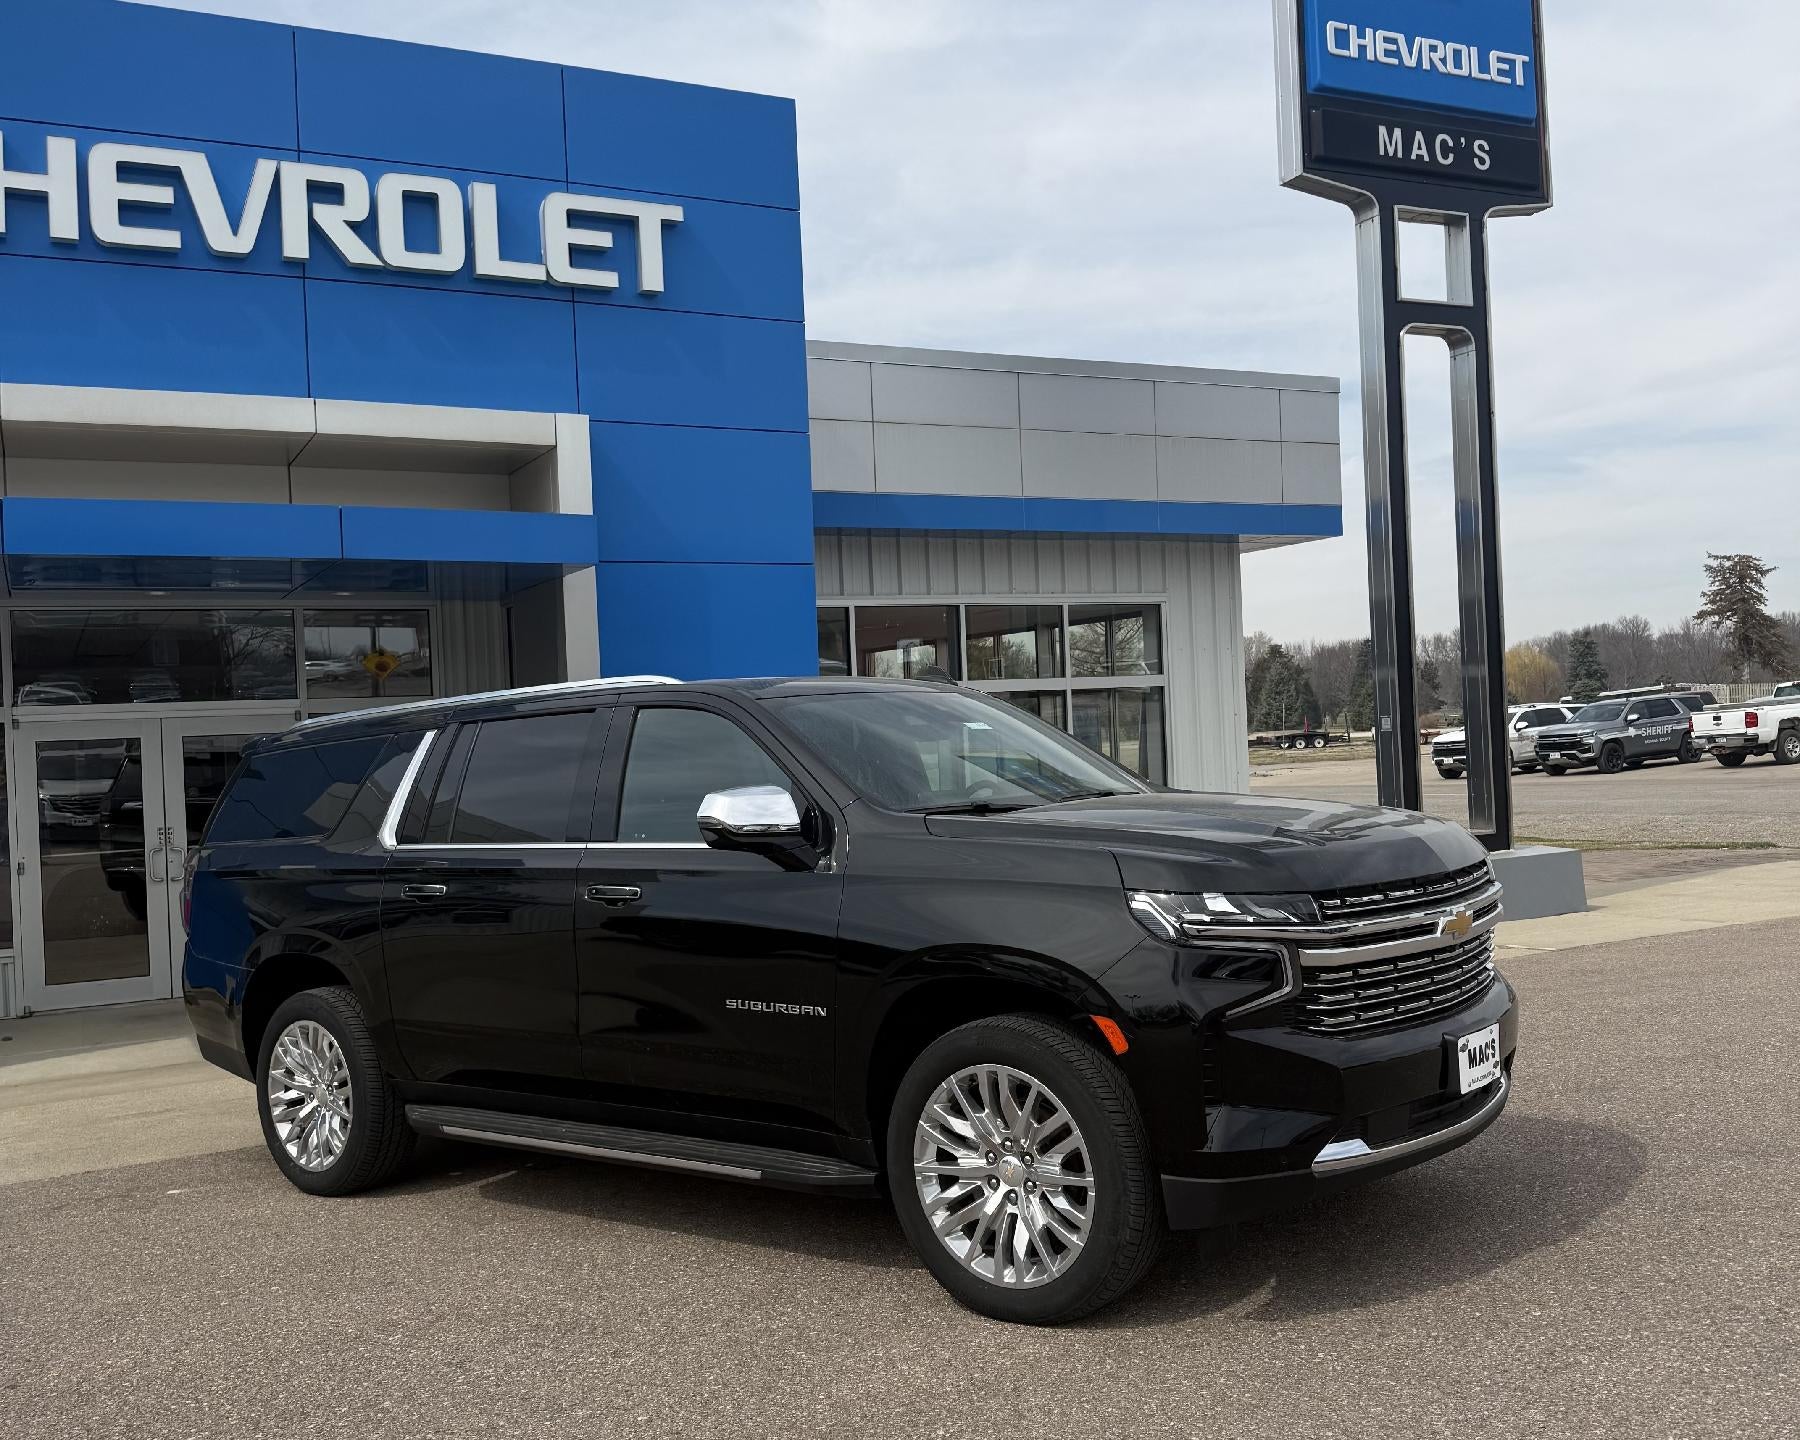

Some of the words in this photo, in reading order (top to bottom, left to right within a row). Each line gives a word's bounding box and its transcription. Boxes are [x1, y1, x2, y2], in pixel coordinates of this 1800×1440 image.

[1326, 20, 1529, 86] CHEVROLET
[1378, 125, 1491, 171] MAC'S
[1641, 725, 1673, 736] SHERIFF
[725, 999, 827, 1016] SUBURBAN
[1467, 1038, 1496, 1069] MAC'S
